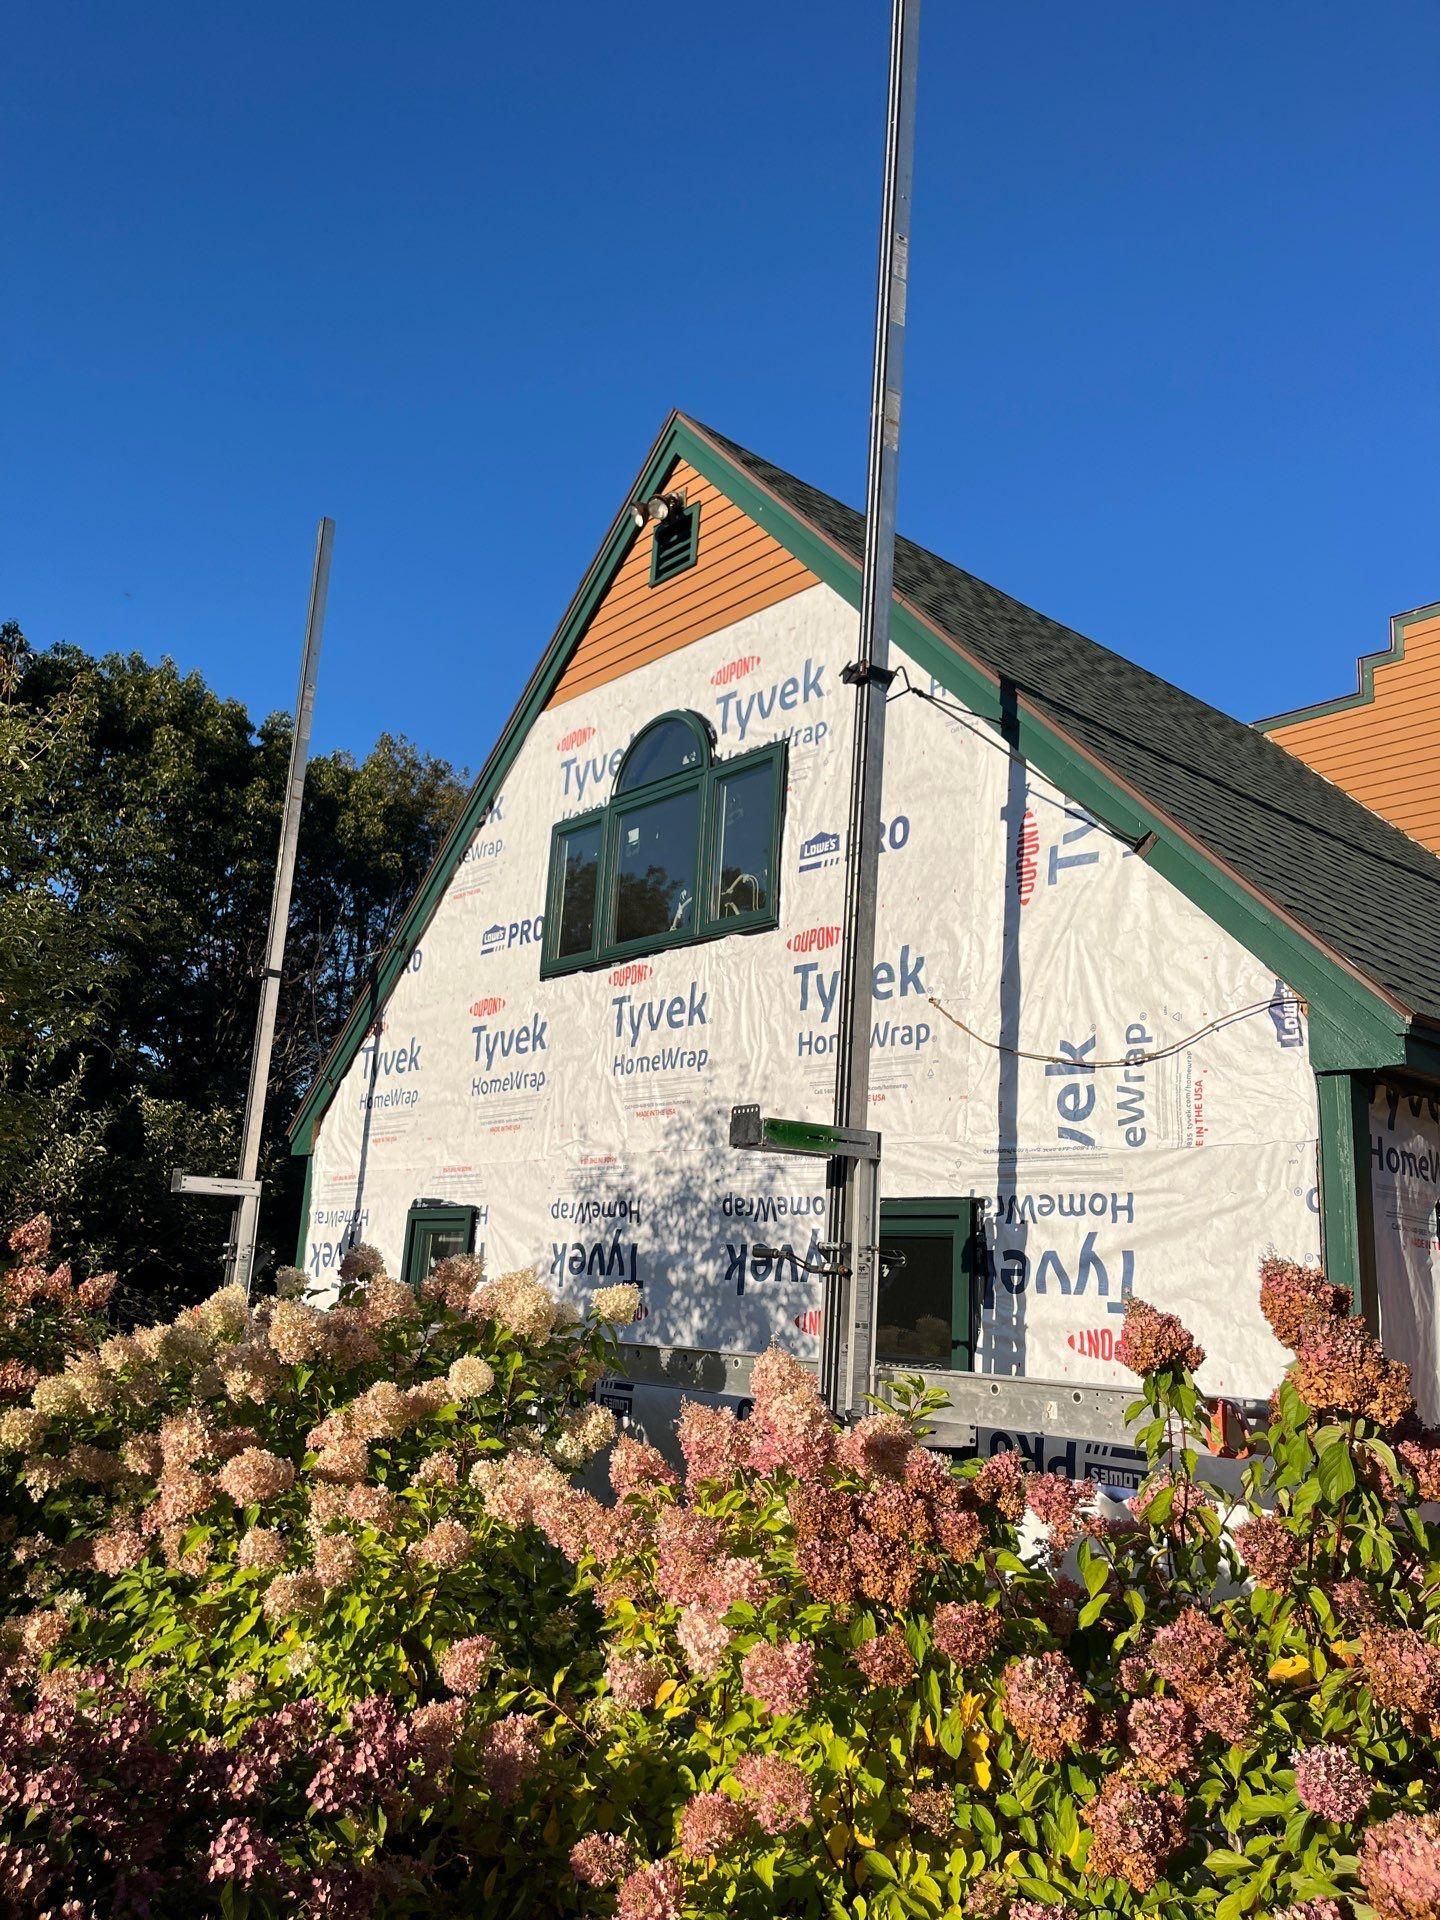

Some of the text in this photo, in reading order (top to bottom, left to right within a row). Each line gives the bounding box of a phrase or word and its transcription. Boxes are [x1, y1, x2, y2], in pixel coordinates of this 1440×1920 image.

[714, 656, 757, 685] DUPONT
[716, 658, 826, 741] Tyvek
[561, 727, 593, 752] DUPONT
[561, 732, 635, 801] Tyve
[464, 839, 503, 864] eWrap
[1016, 820, 1040, 896] DUPONT
[793, 925, 841, 952] DUPONT
[613, 964, 648, 987] DUPONT
[793, 943, 926, 1023] Tyek
[473, 997, 501, 1017] DUPONT
[612, 981, 708, 1047] Tyvek
[472, 1013, 548, 1071] Tyvek
[798, 1020, 931, 1057] HoWrap
[613, 1047, 709, 1077] HomeWrap
[471, 1070, 546, 1096] HomeWrap
[1116, 1023, 1153, 1148] eWrap
[1195, 1079, 1204, 1098] USA
[359, 1087, 419, 1110] HomeWrap
[1195, 1103, 1203, 1126] THE
[551, 1199, 641, 1225] HomeWrap
[722, 1191, 826, 1223] omeWrap
[550, 1229, 644, 1289] Tyvek
[724, 1229, 824, 1296] yvek
